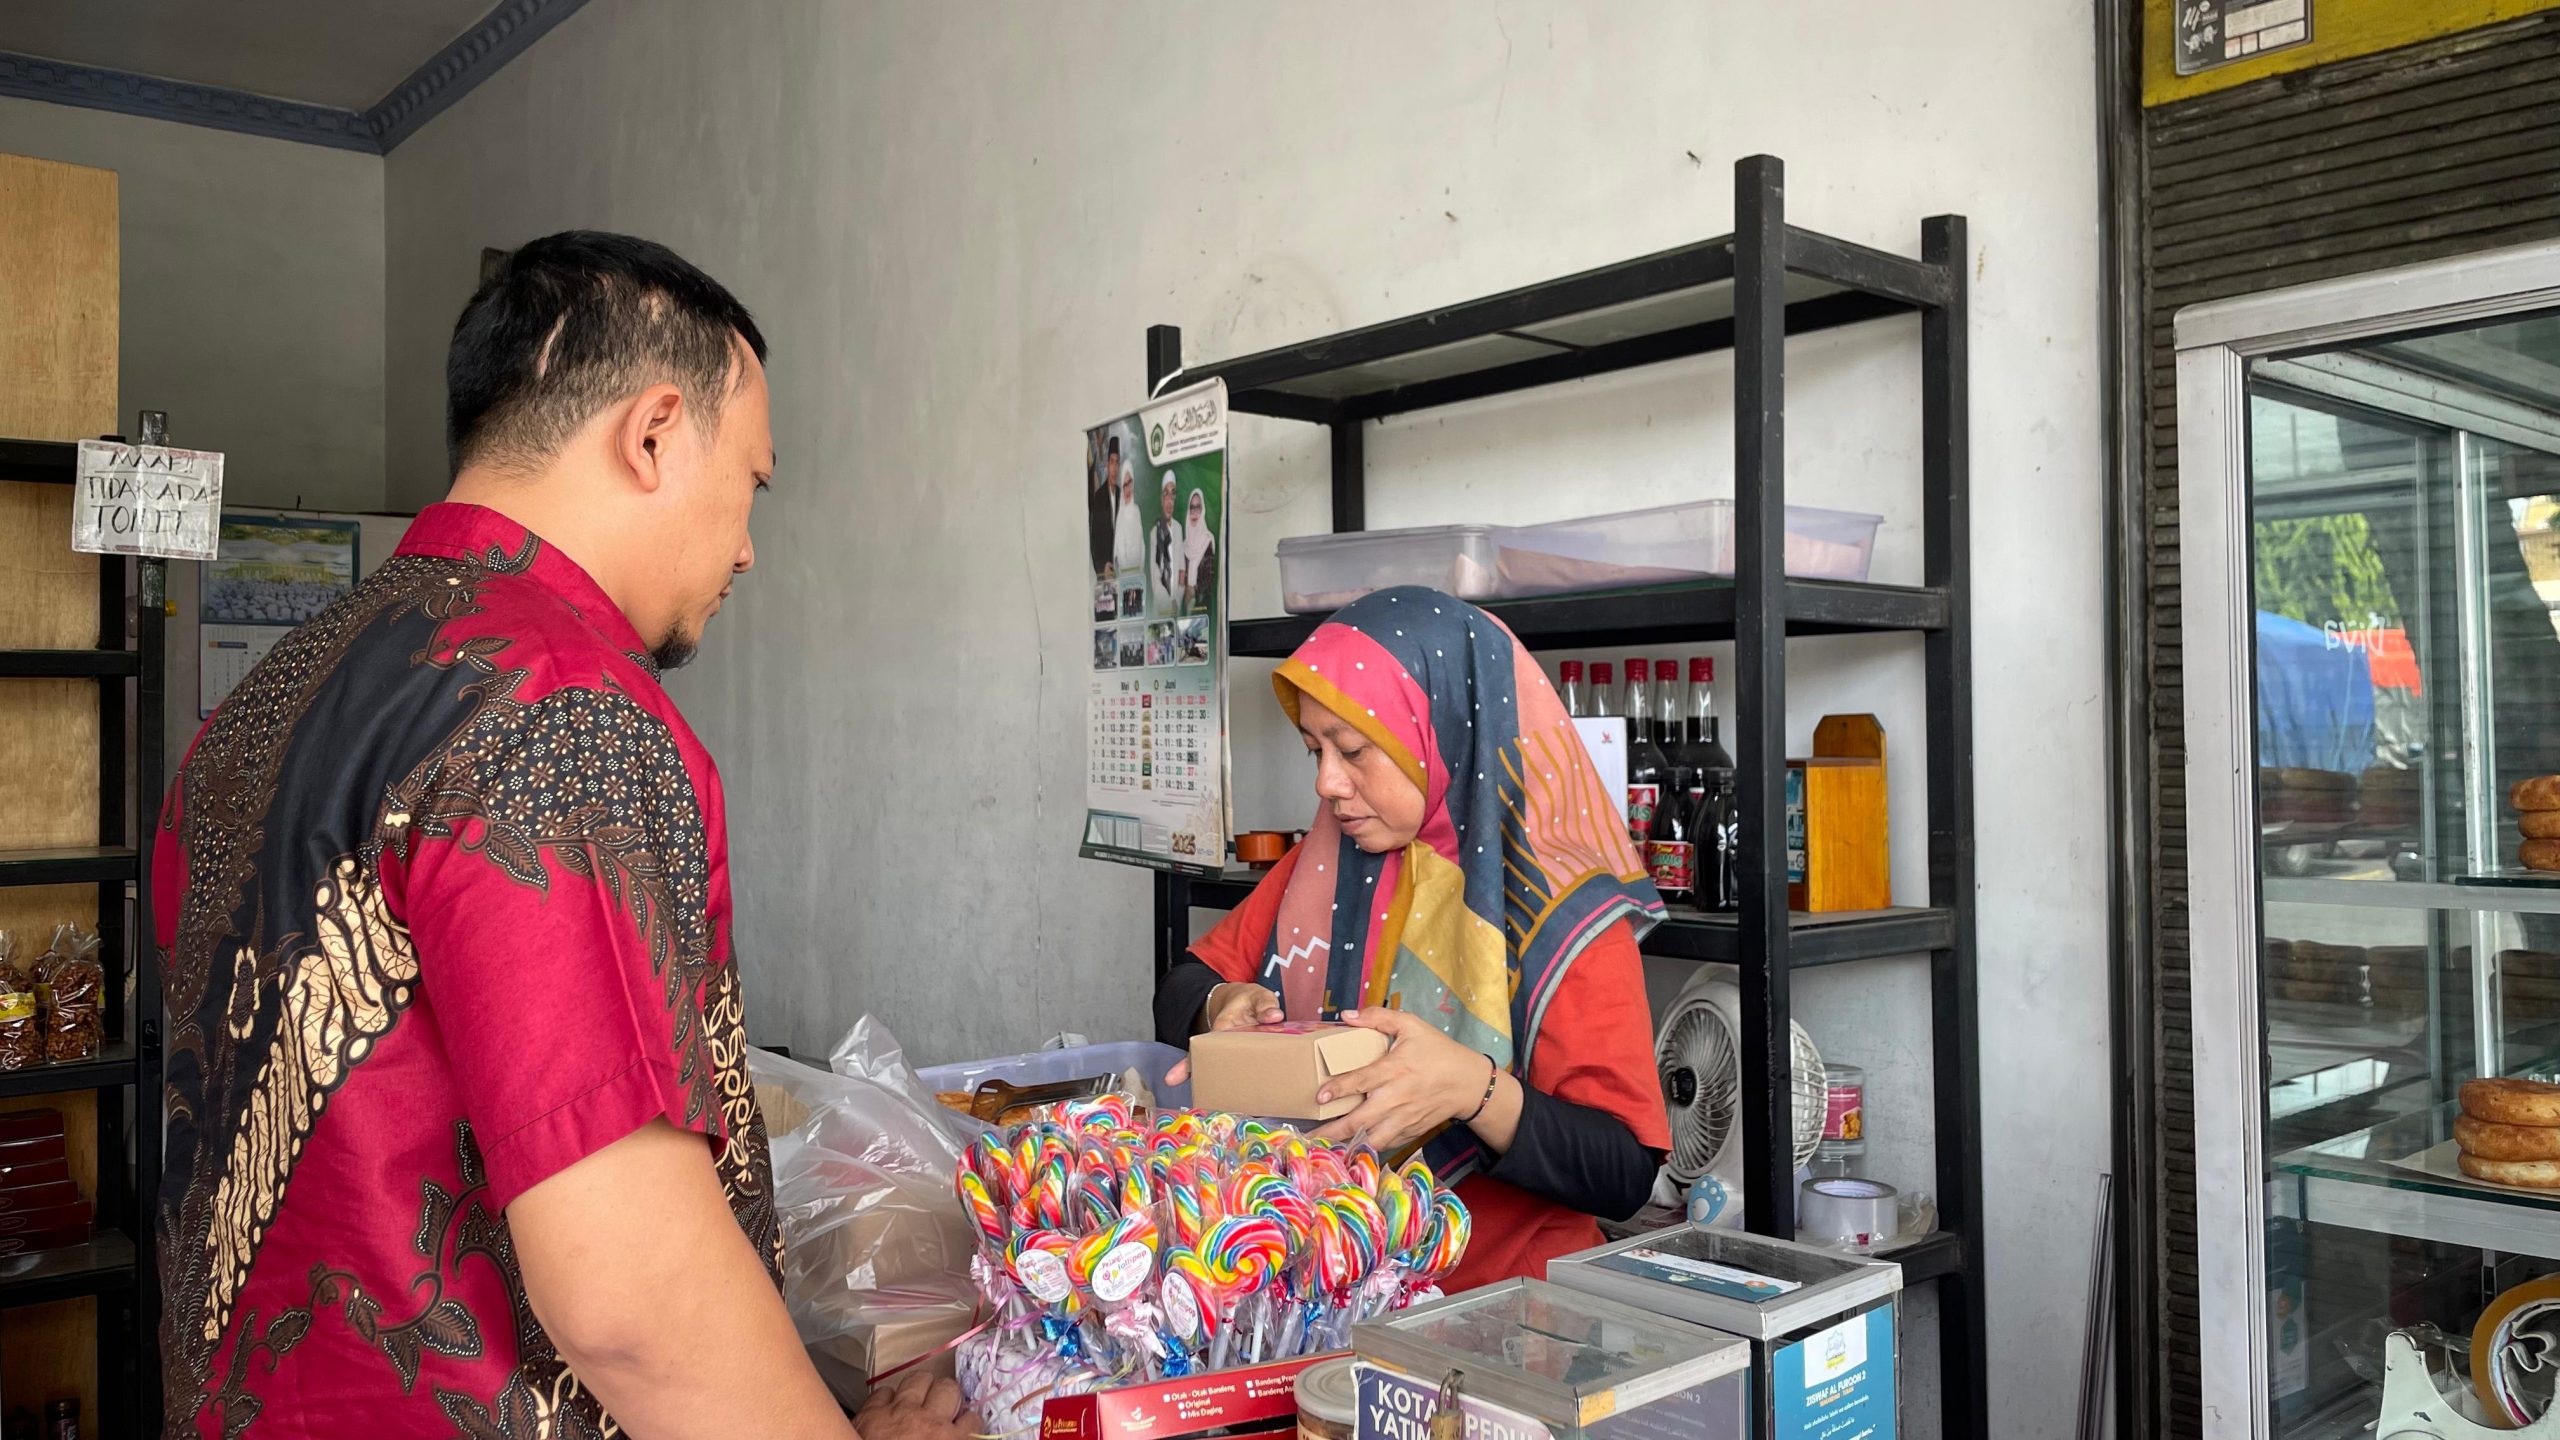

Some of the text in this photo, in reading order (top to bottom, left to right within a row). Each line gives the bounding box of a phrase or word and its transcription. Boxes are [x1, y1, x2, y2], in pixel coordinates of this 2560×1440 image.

[109, 451, 194, 474] MAAF!!
[84, 475, 209, 504] TIDAK ADA
[90, 504, 187, 536] TOILET
[1165, 680, 1176, 689] Juni
[1118, 1250, 1147, 1270] lollipop
[1255, 1377, 1282, 1387] Bandeng
[1806, 1387, 1829, 1407] ZISWAF
[1830, 1384, 1837, 1395] AL
[1838, 1371, 1861, 1391] FURQON
[1861, 1370, 1866, 1380] 2
[1171, 1392, 1188, 1401] Otak
[1191, 1389, 1208, 1398] Otak
[1208, 1384, 1236, 1395] Bandeng
[1257, 1387, 1284, 1397] Bandeng
[1695, 1394, 1701, 1405] 2
[1185, 1397, 1211, 1408] Original
[1378, 1379, 1533, 1440] KOTA PED
[1187, 1406, 1224, 1418] Mix Daging
[1370, 1404, 1431, 1440] YATIM
